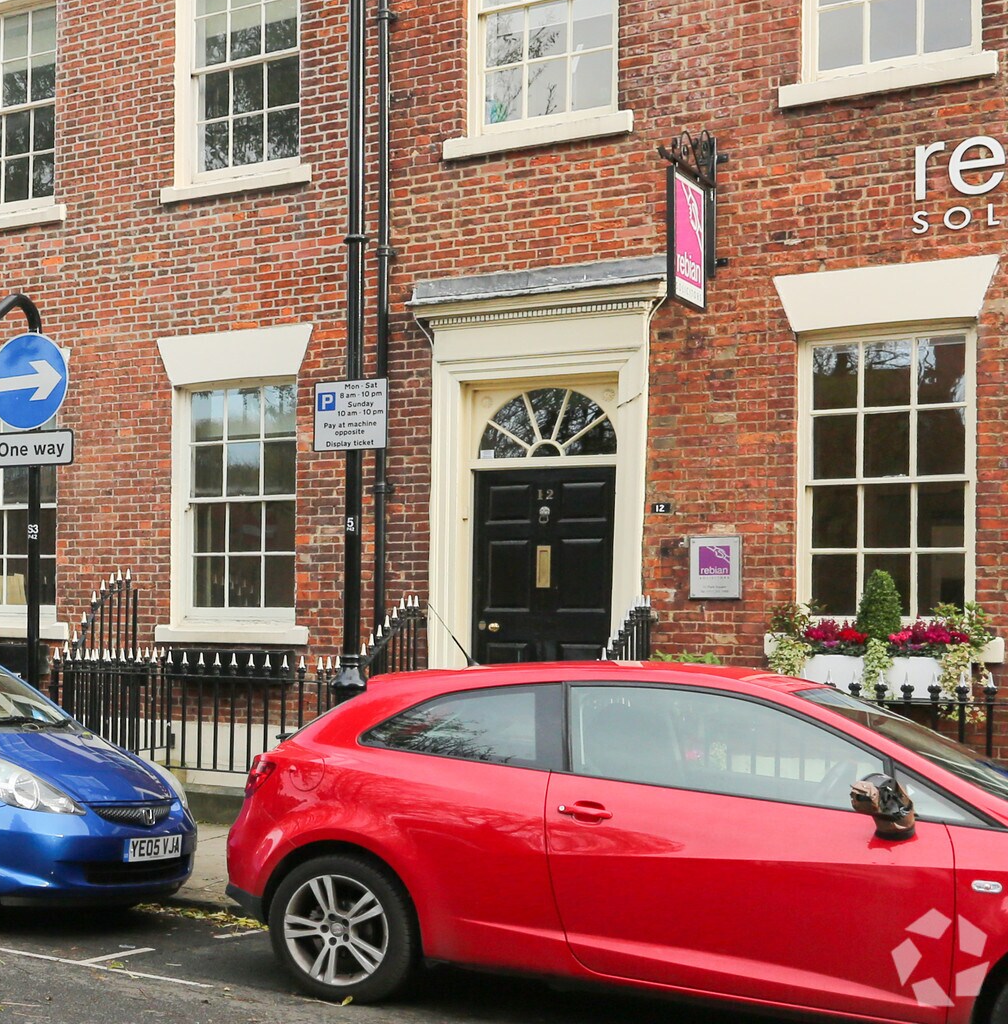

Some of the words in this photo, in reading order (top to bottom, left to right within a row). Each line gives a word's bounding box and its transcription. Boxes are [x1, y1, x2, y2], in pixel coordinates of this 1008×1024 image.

[915, 135, 1006, 201] re
[912, 203, 1001, 234] SOL
[676, 251, 701, 284] rebian
[322, 394, 334, 410] P
[33, 443, 65, 458] way
[537, 489, 554, 500] 12
[655, 504, 665, 512] 12
[700, 566, 728, 575] rebian
[131, 839, 161, 857] YE05
[162, 836, 180, 855] VJA
